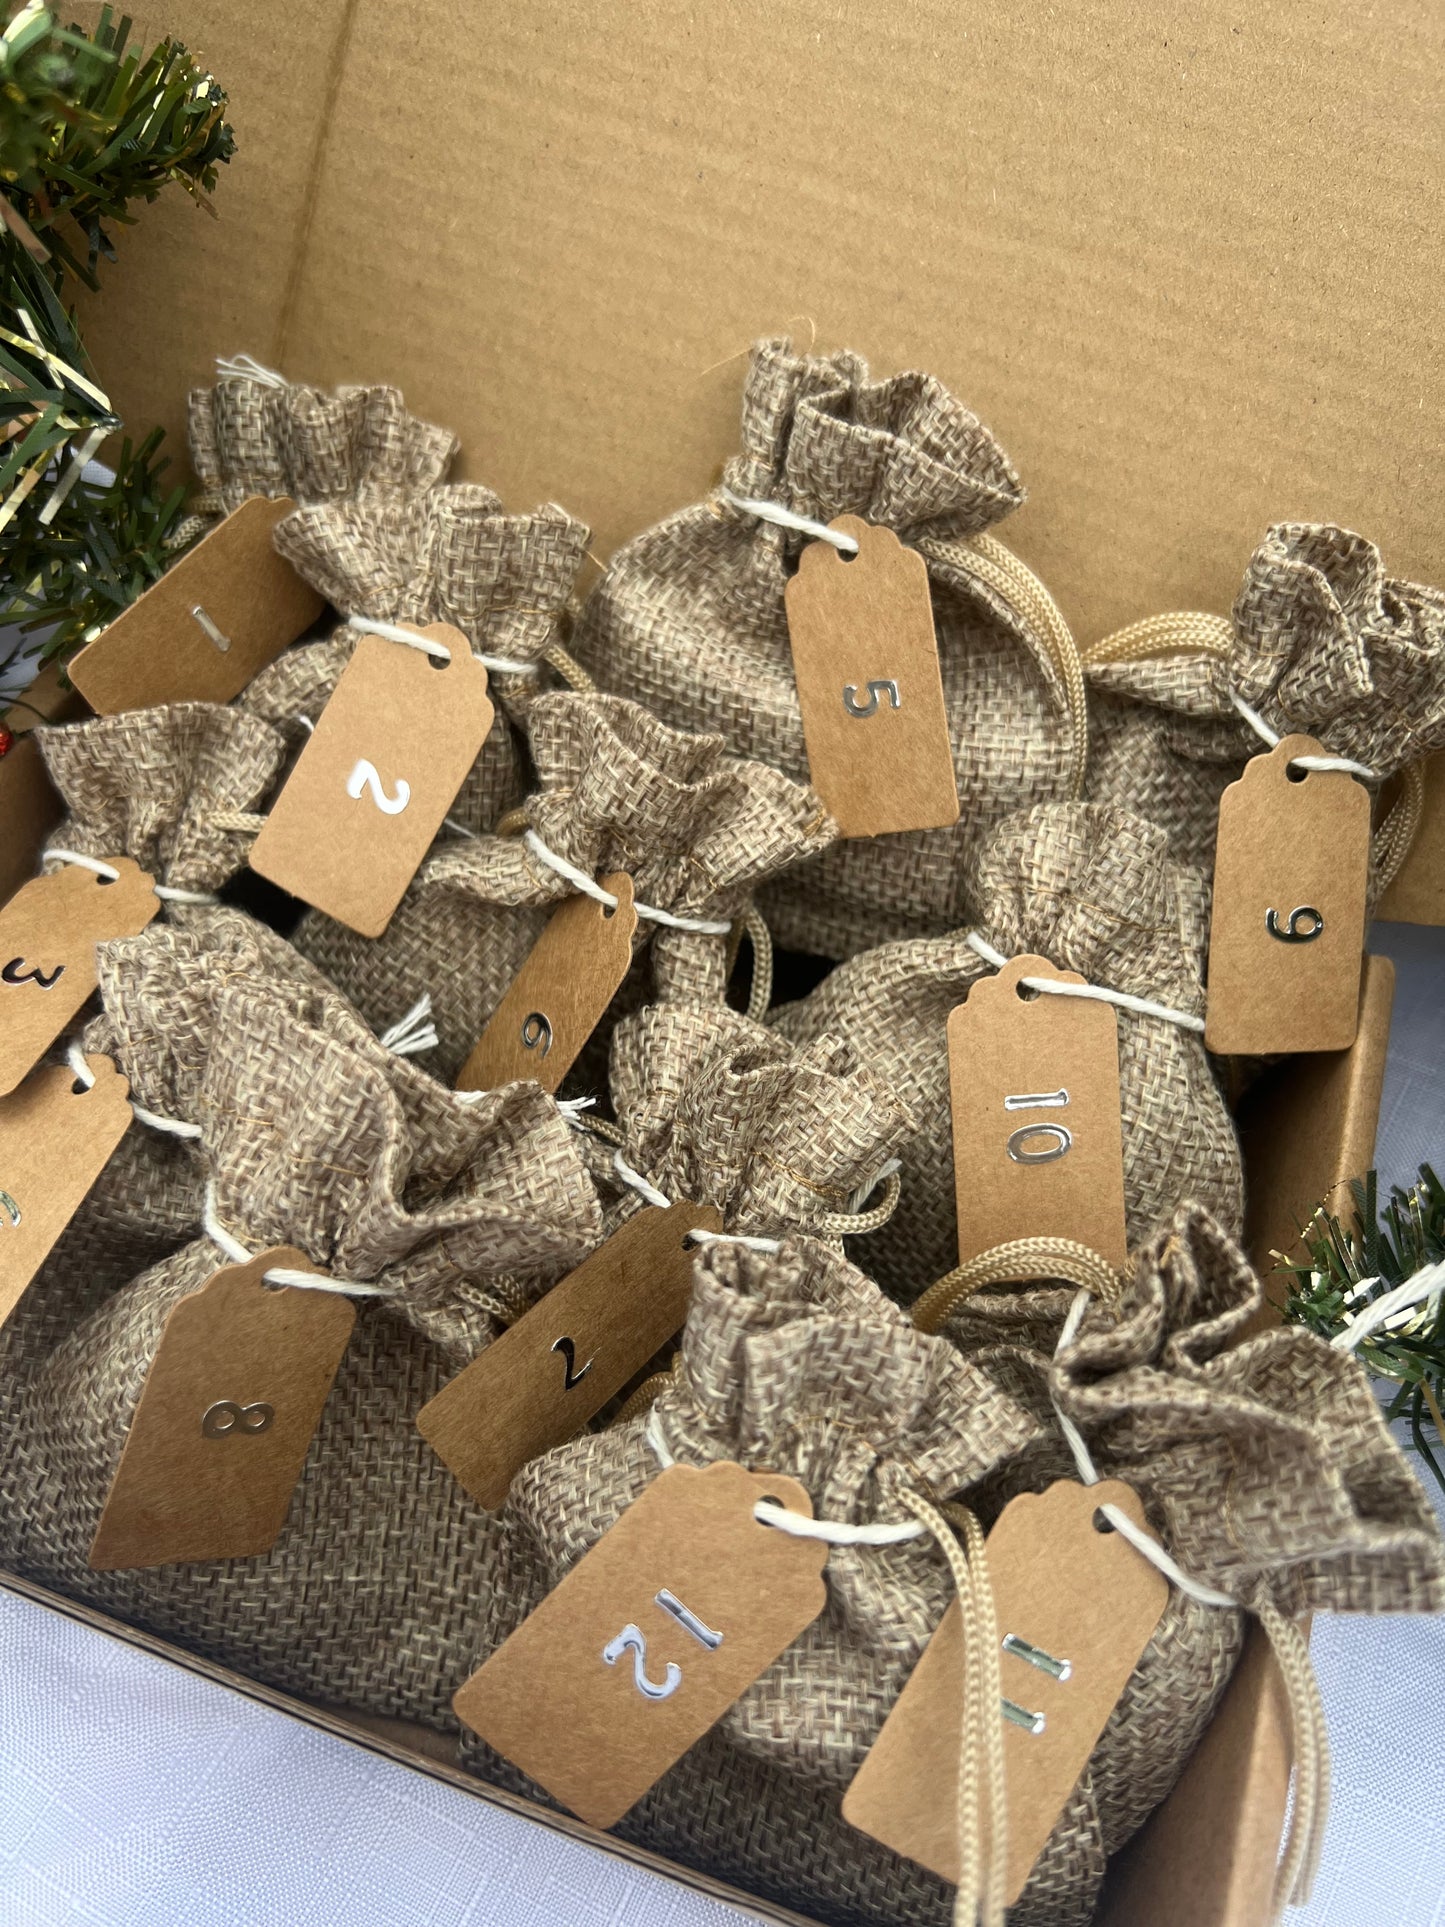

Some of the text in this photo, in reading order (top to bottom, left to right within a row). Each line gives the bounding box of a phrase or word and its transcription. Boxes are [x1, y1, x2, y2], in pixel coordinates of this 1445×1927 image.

[843, 678, 901, 719] 5
[346, 758, 411, 815] 2
[1264, 903, 1325, 946] 9
[1, 957, 66, 991] 3
[1005, 1086, 1073, 1166] 10
[201, 1400, 276, 1439] 8
[603, 1587, 724, 1700] 12
[1001, 1632, 1073, 1735] 11
